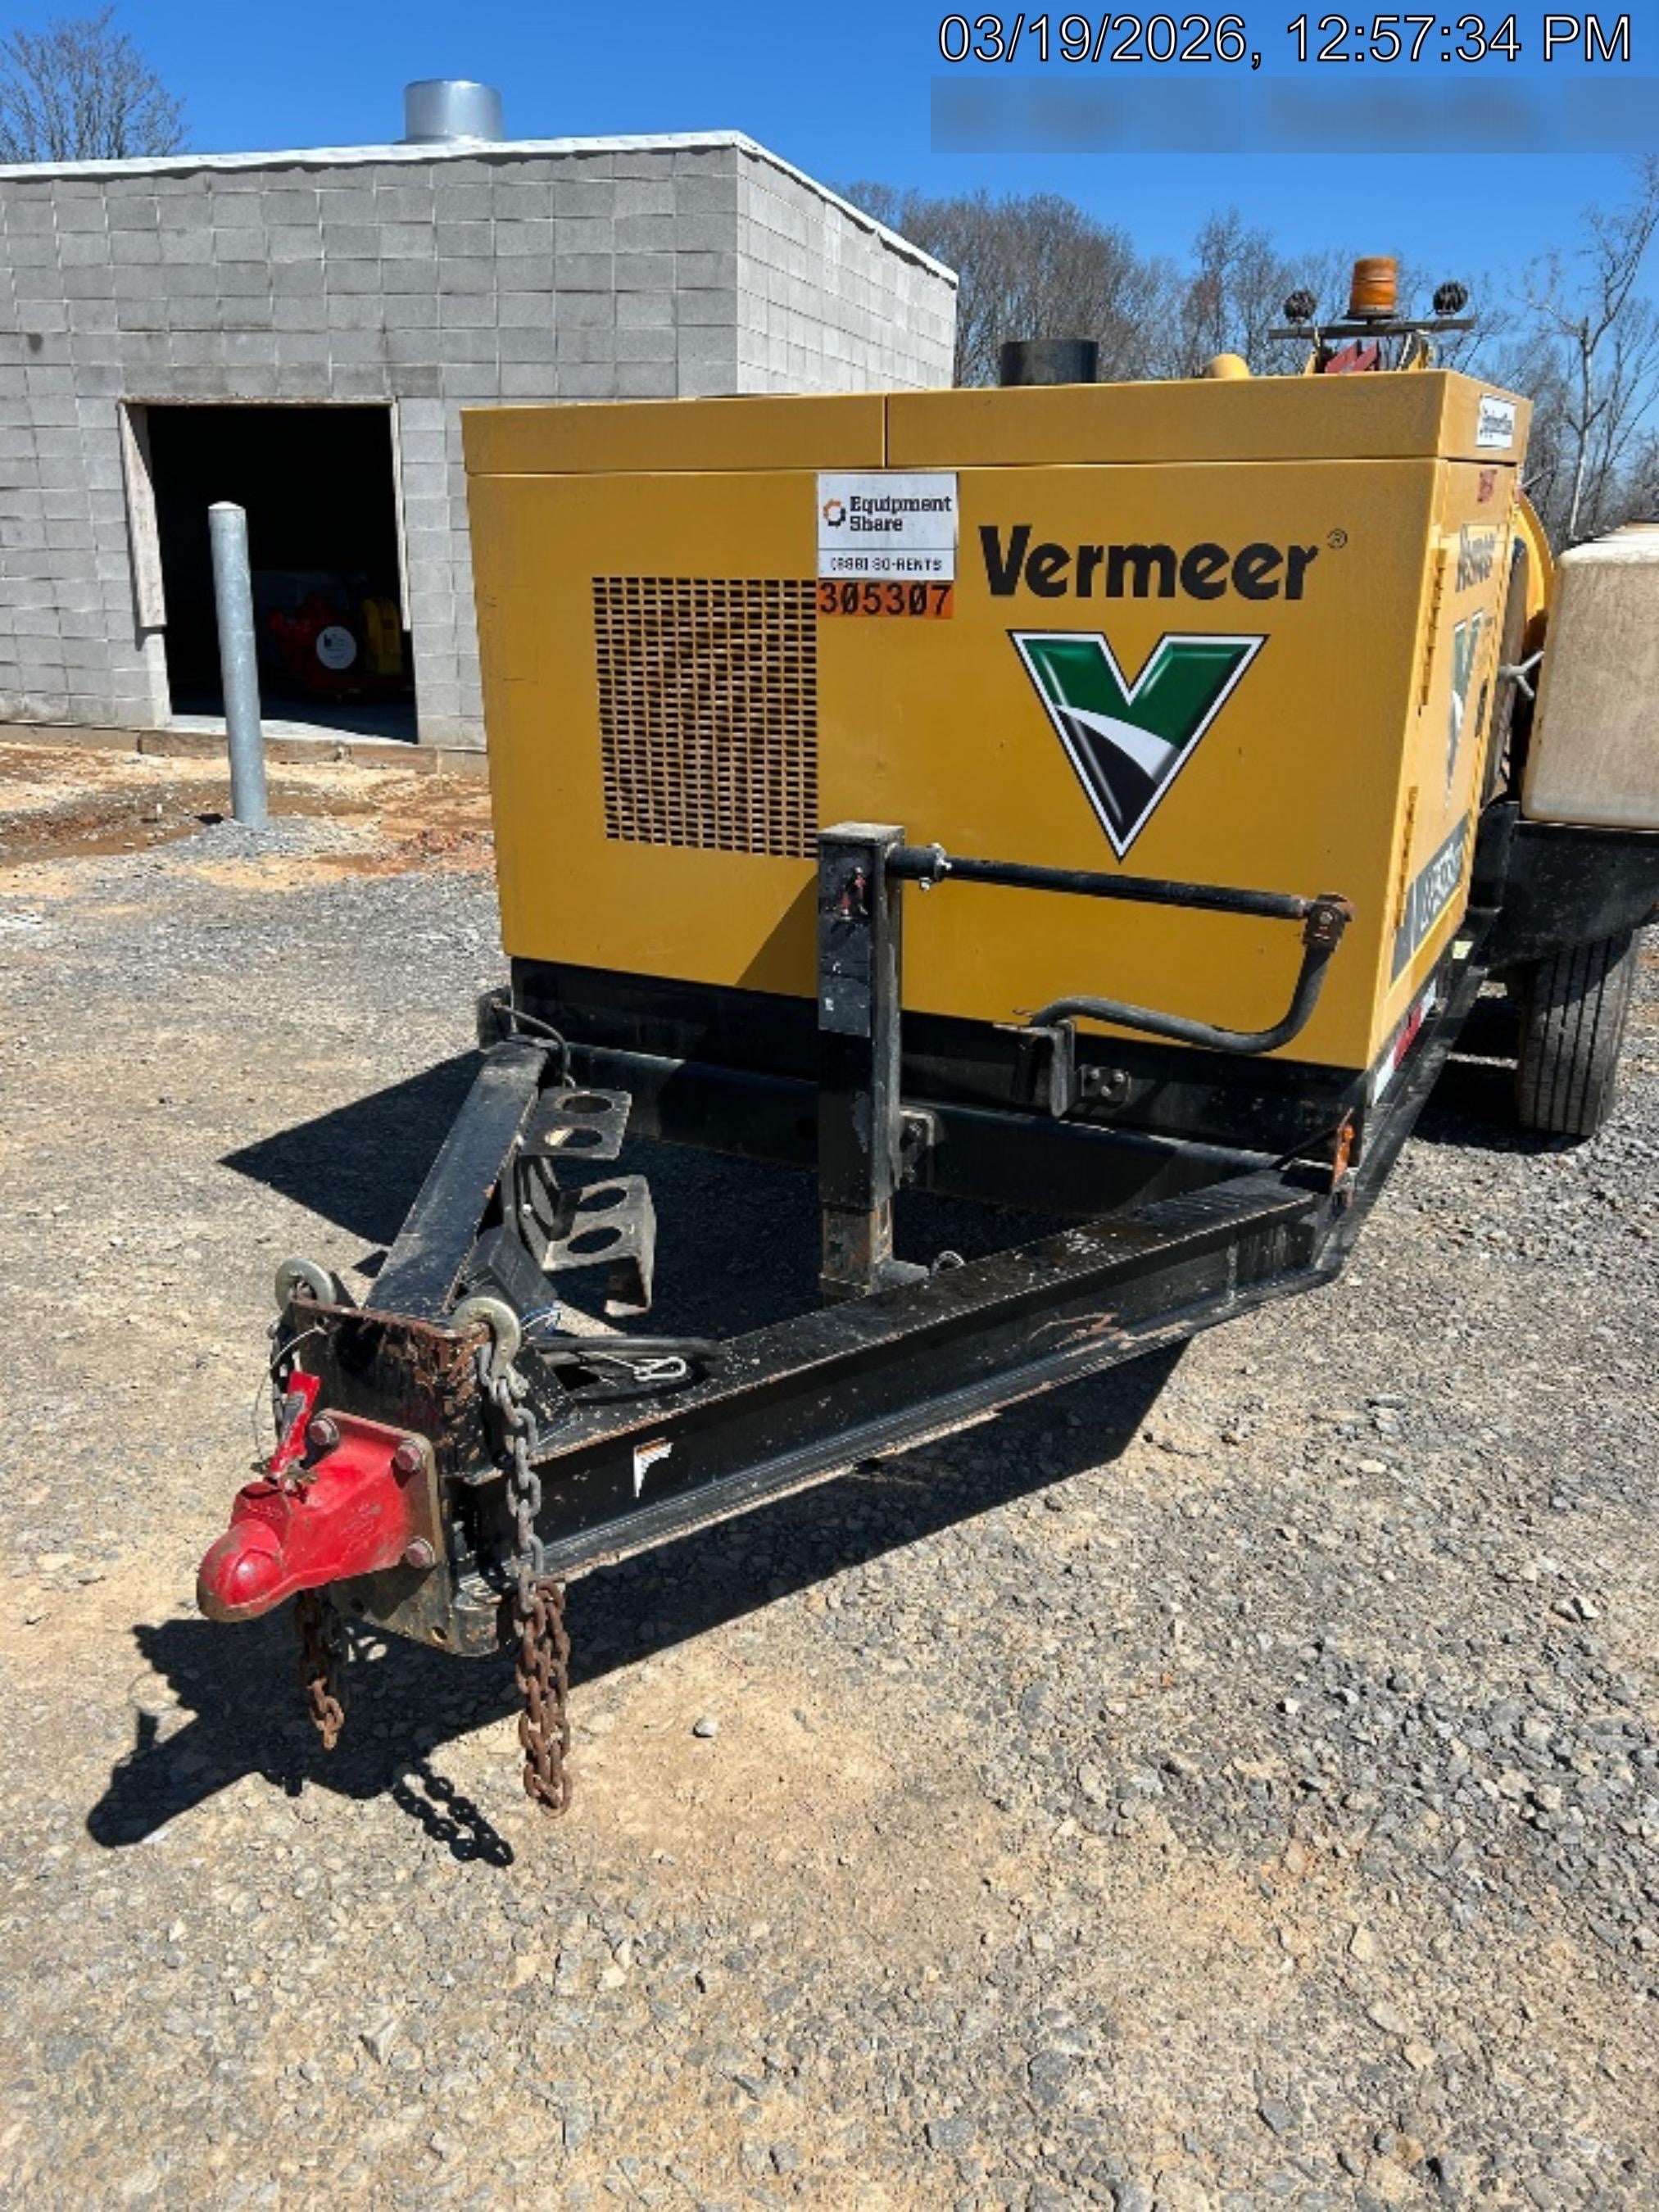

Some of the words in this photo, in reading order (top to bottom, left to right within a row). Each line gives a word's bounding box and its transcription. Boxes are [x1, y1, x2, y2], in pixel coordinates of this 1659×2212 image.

[850, 496, 952, 514] Equipment
[850, 516, 903, 532] Share
[978, 525, 1319, 600] Vermeer
[820, 582, 952, 615] 305307
